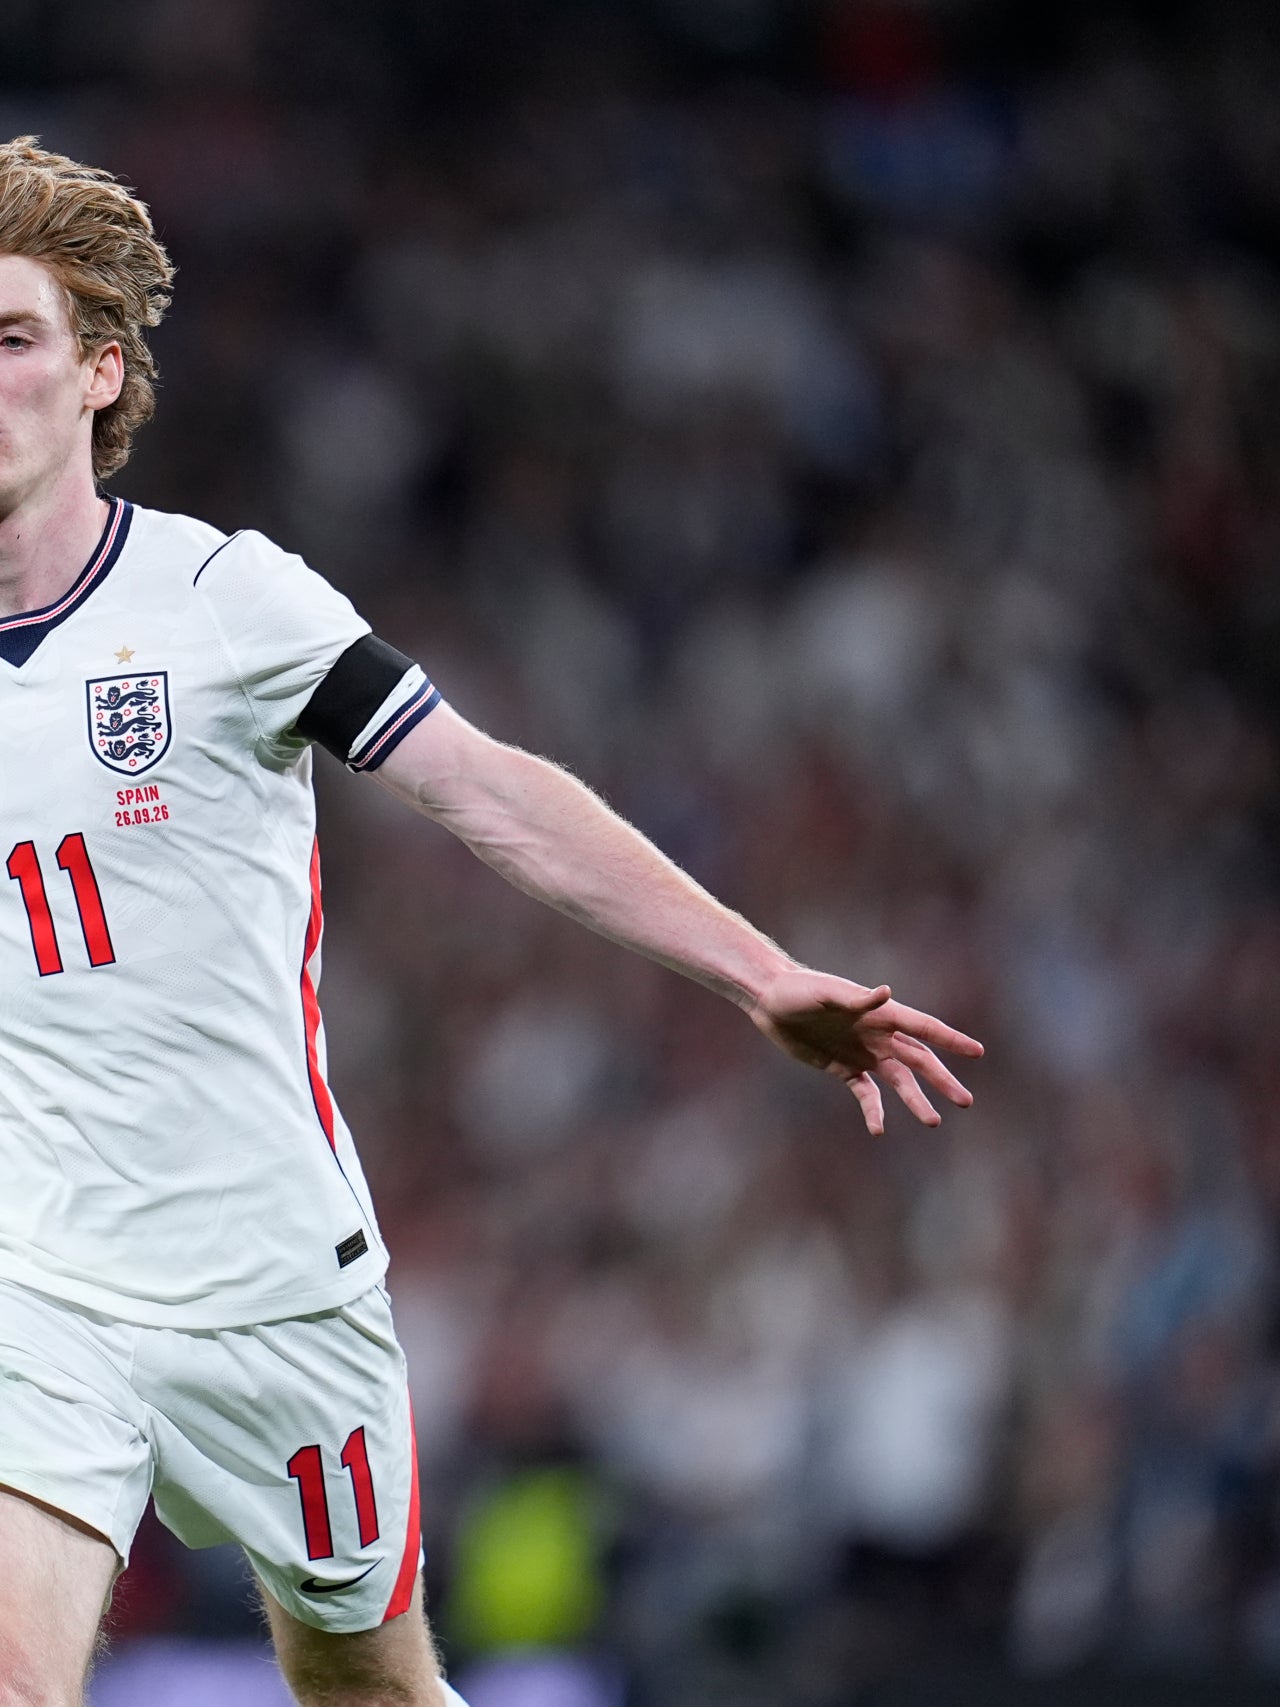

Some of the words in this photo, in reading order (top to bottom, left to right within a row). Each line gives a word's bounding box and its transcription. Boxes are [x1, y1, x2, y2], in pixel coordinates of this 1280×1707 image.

[115, 804, 170, 827] 26.09.26
[116, 785, 160, 806] SPAIN
[6, 832, 116, 977] 11
[286, 1425, 380, 1561] 11
